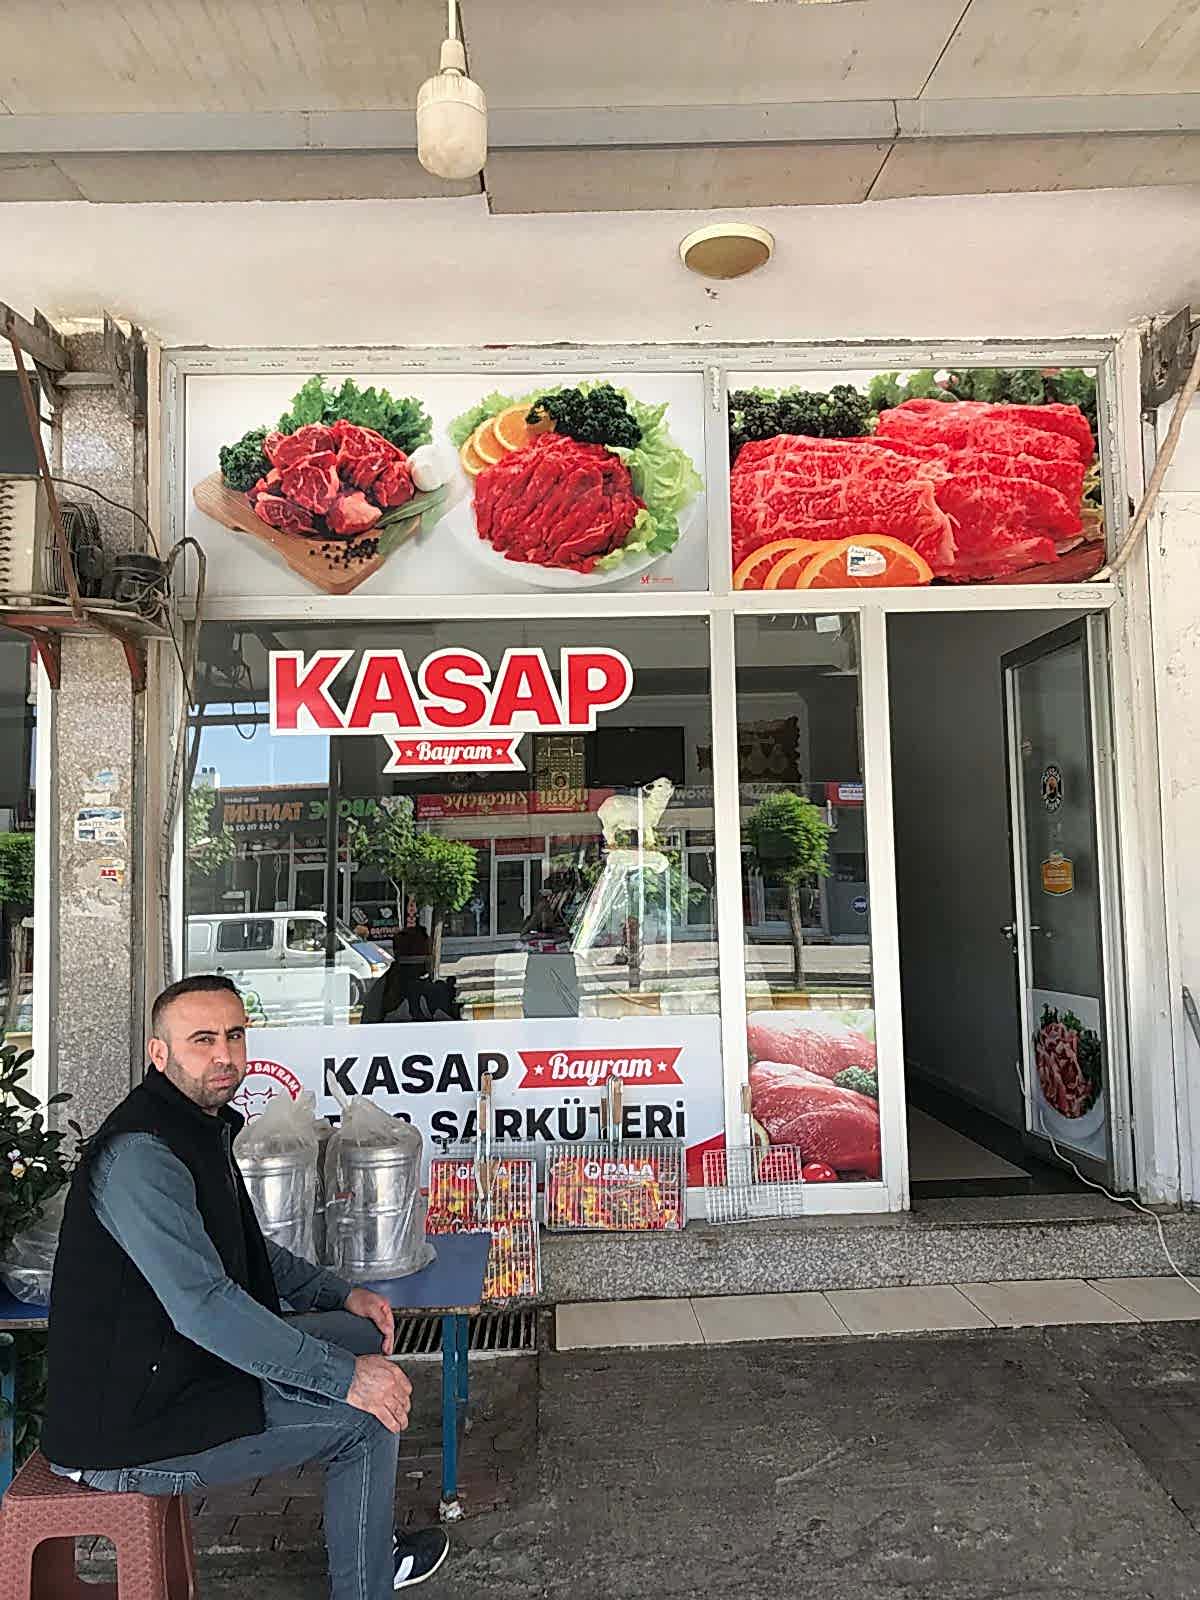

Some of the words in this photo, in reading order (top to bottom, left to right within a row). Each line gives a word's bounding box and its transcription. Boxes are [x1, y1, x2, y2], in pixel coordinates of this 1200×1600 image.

[272, 650, 629, 733] KASAP
[416, 741, 493, 765] Bayram
[254, 1062, 301, 1094] BAYRAM
[324, 1053, 509, 1096] KASAP
[548, 1053, 653, 1087] Bayram
[603, 1163, 654, 1176] PALA
